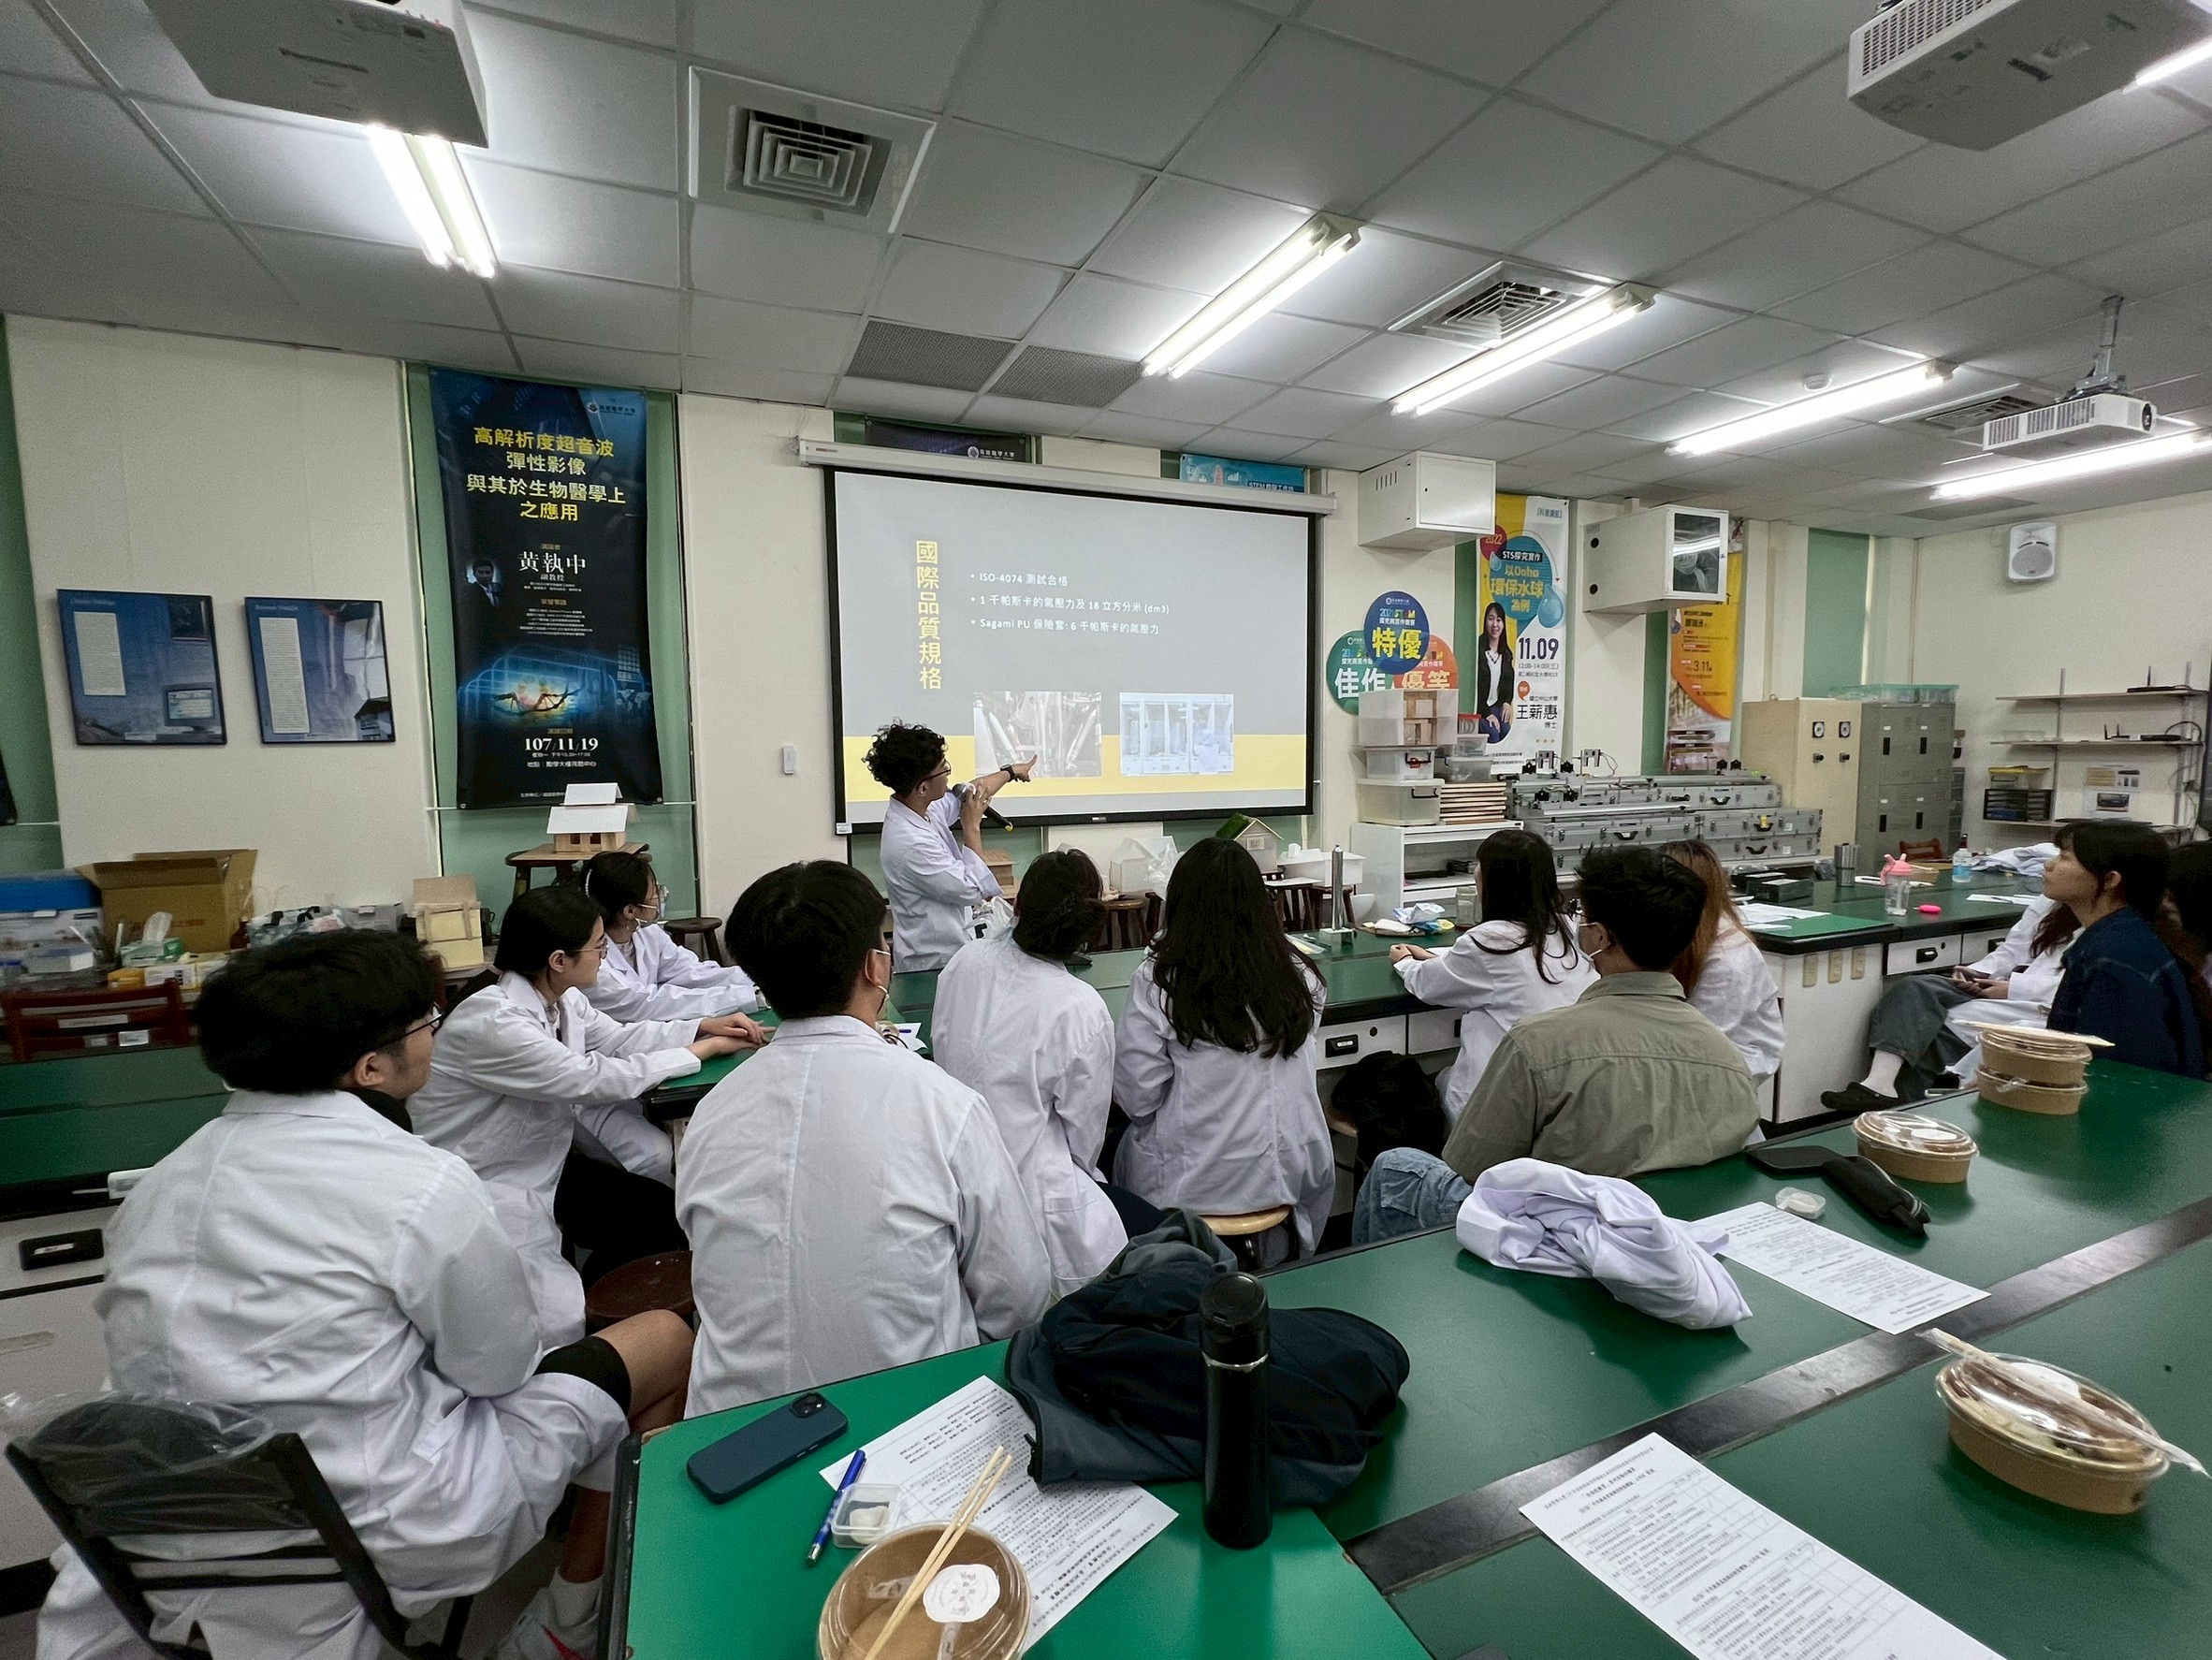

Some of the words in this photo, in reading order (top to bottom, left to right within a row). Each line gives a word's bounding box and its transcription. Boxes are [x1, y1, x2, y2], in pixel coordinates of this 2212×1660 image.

[473, 426, 614, 458] 高解析度超音波
[506, 451, 587, 475] 彈性影像
[466, 473, 626, 504] 與其於生物醫學上
[520, 501, 578, 521] 之應用
[979, 573, 1023, 584] ISO-4074
[1026, 573, 1069, 587] 測試合格
[1491, 578, 1545, 597] 環保水球
[915, 540, 942, 690] 國際品質規格
[980, 595, 986, 604] 1
[989, 594, 1085, 610] 千帕斯卡的氣壓力及
[1088, 601, 1099, 611] 18
[1102, 601, 1142, 614] 立方分米
[1143, 604, 1170, 617] (dm3)
[1511, 599, 1530, 612] 為例
[980, 618, 1015, 630] Sagami
[1017, 619, 1030, 629] PU
[1070, 621, 1077, 631] 6
[1080, 620, 1159, 635] 千帕斯卡的氣壓力
[1372, 626, 1422, 660] 特優
[1518, 637, 1560, 660] 11.09
[1334, 667, 1386, 699] 佳作
[1516, 704, 1558, 720] 王薪惠
[525, 737, 599, 751] 107/11/19
